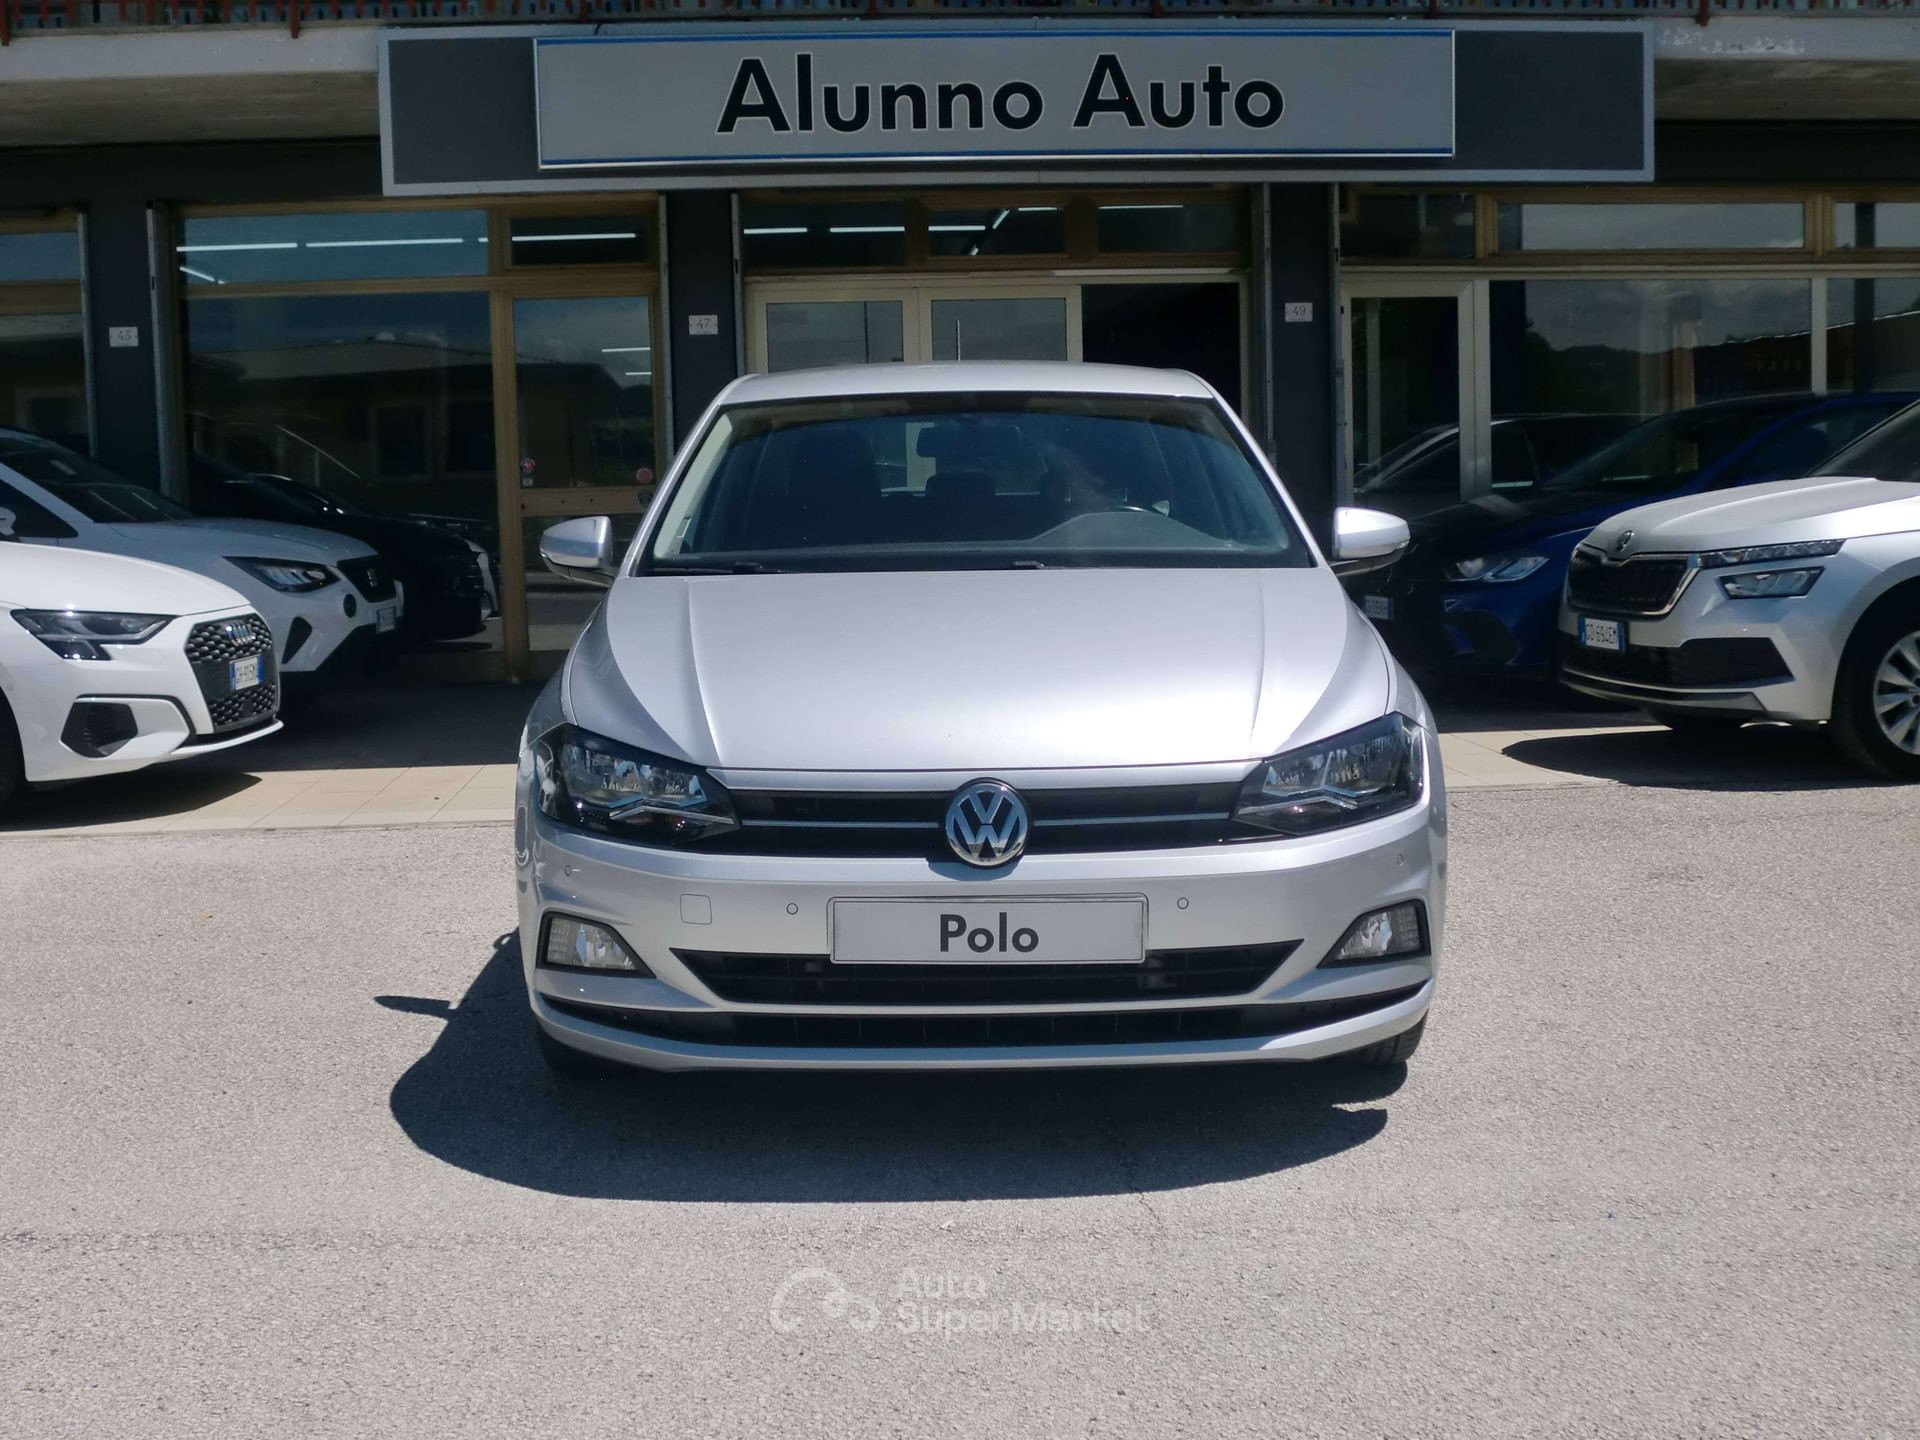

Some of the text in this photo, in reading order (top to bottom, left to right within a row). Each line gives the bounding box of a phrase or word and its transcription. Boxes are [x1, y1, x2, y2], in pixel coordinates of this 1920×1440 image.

[716, 52, 1285, 133] Alunno Auto
[940, 911, 1040, 953] Polo
